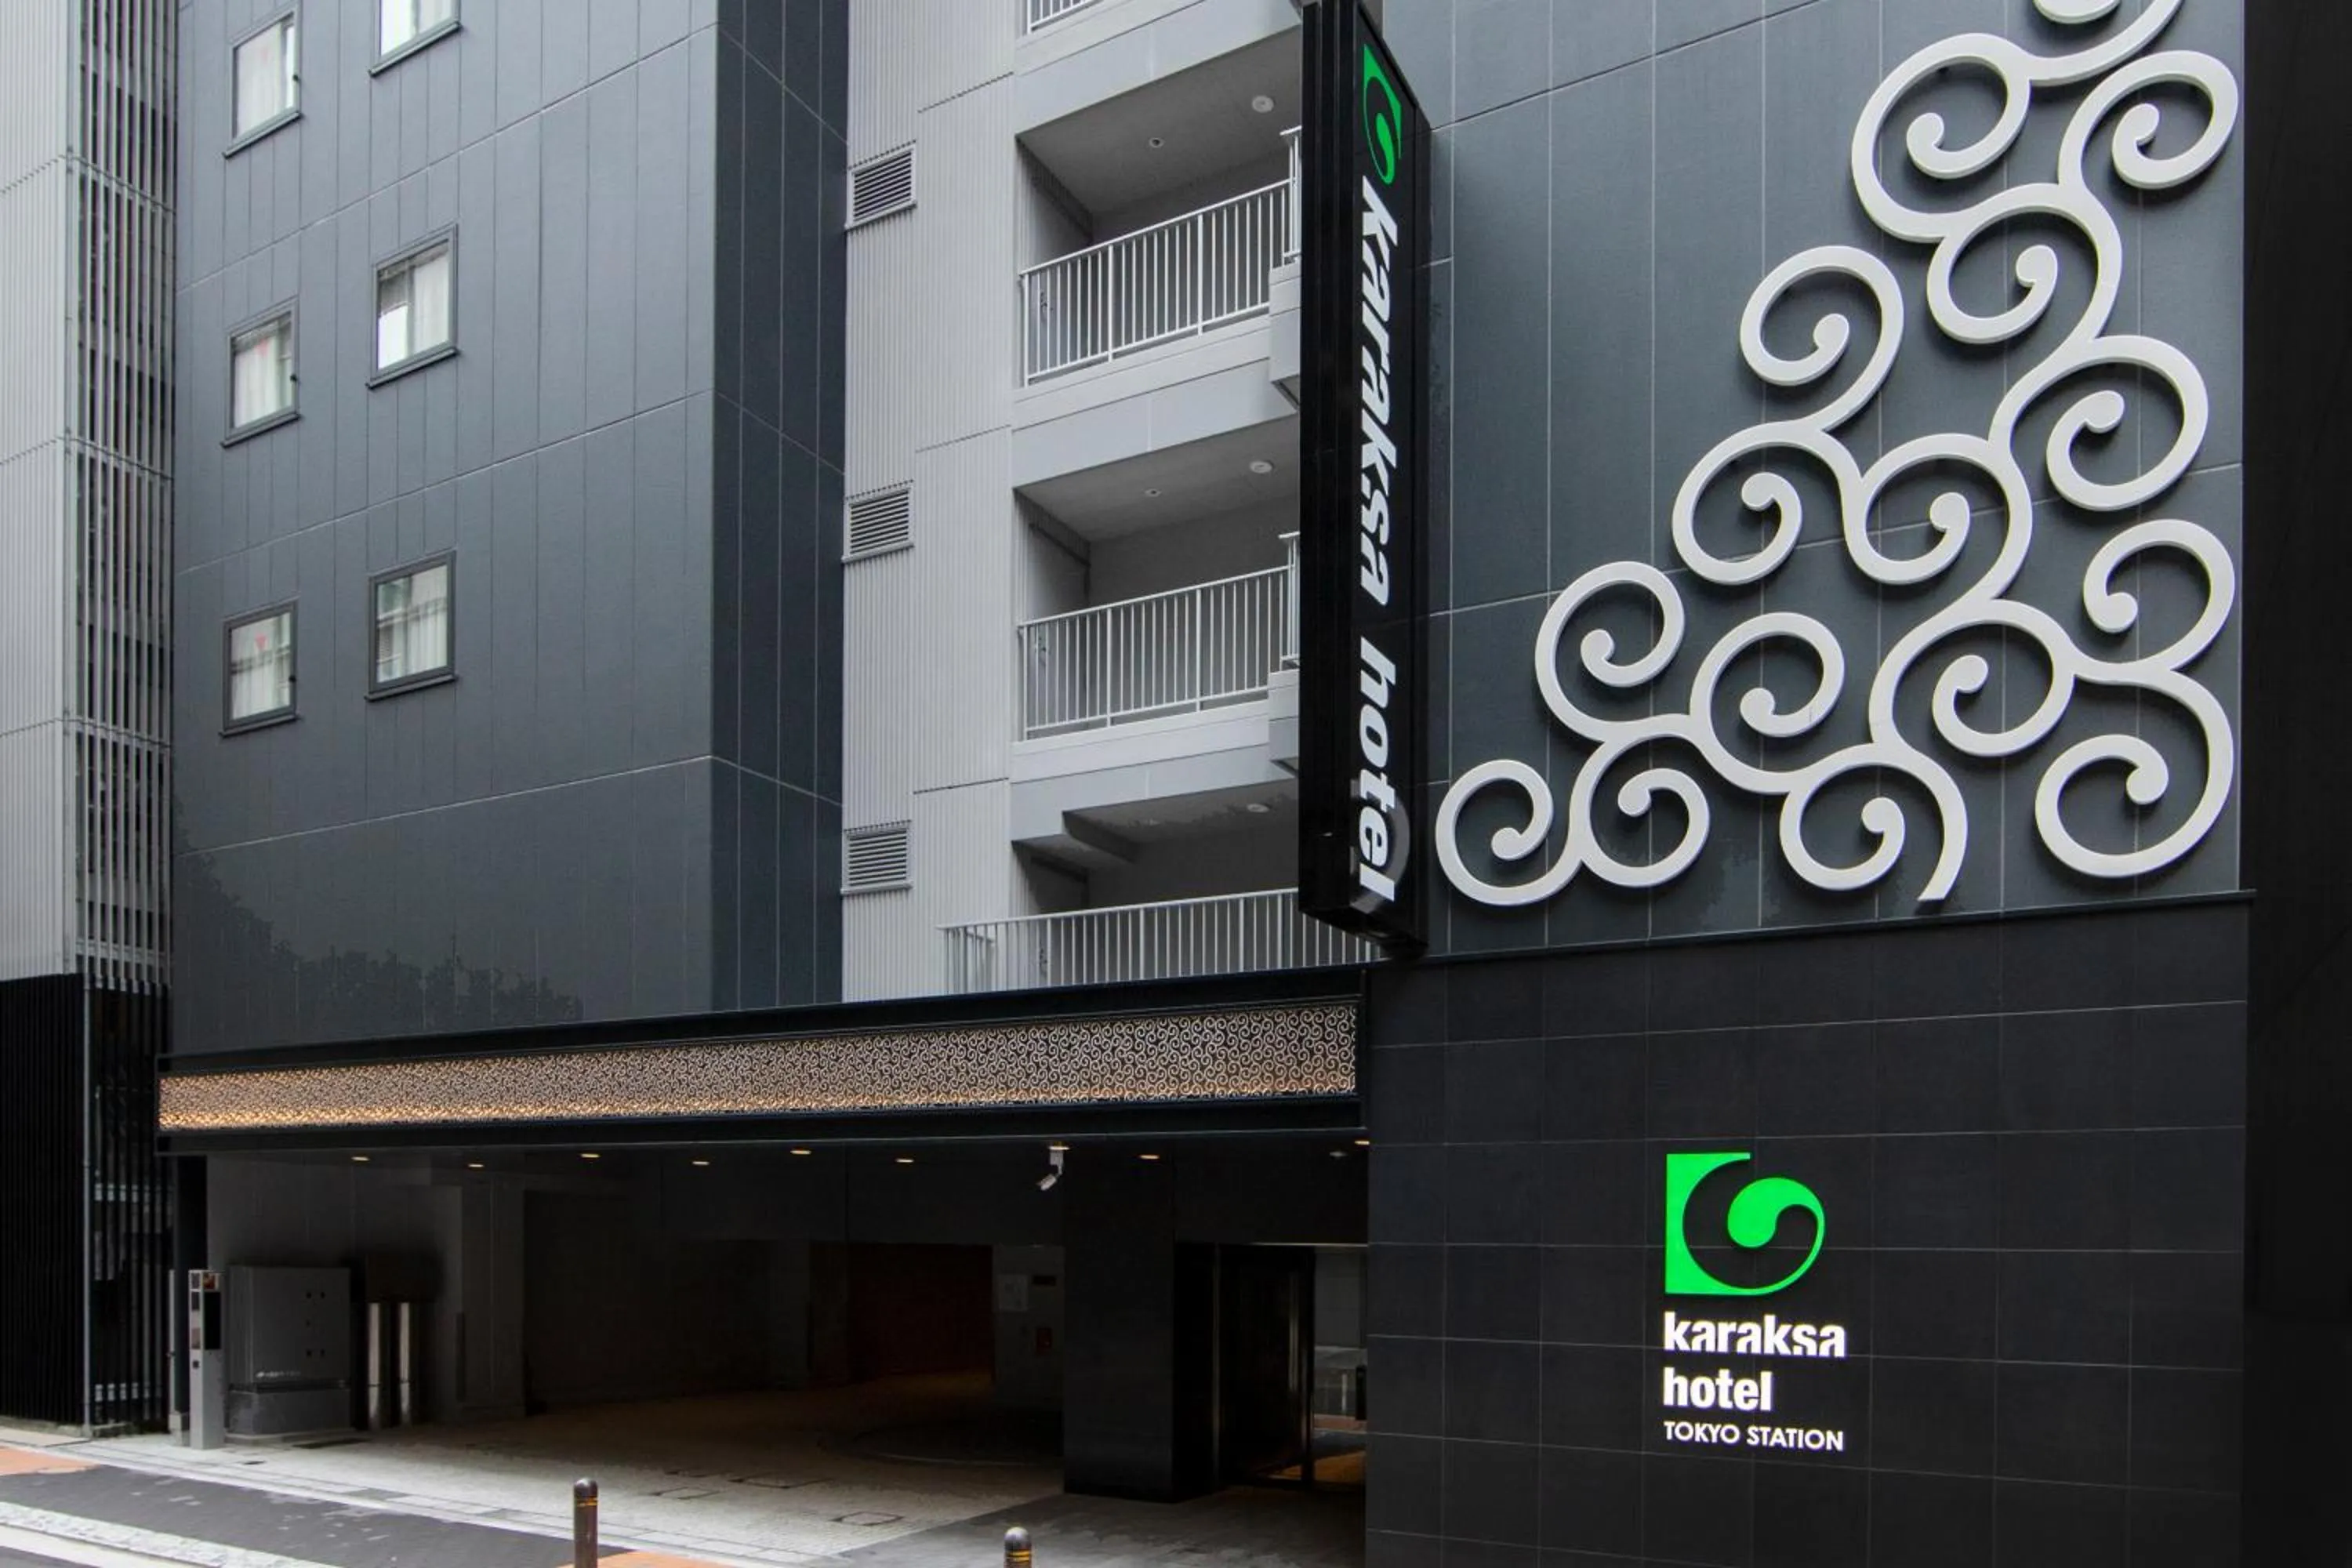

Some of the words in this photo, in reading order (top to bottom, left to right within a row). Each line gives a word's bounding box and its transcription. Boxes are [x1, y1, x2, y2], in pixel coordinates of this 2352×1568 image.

[1361, 176, 1399, 606] karaksa
[1359, 637, 1396, 902] hotel
[1663, 1311, 1846, 1359] karaksa
[1662, 1366, 1773, 1412] hotel
[1664, 1421, 1741, 1444] TOKYO
[1745, 1426, 1844, 1451] STATION
